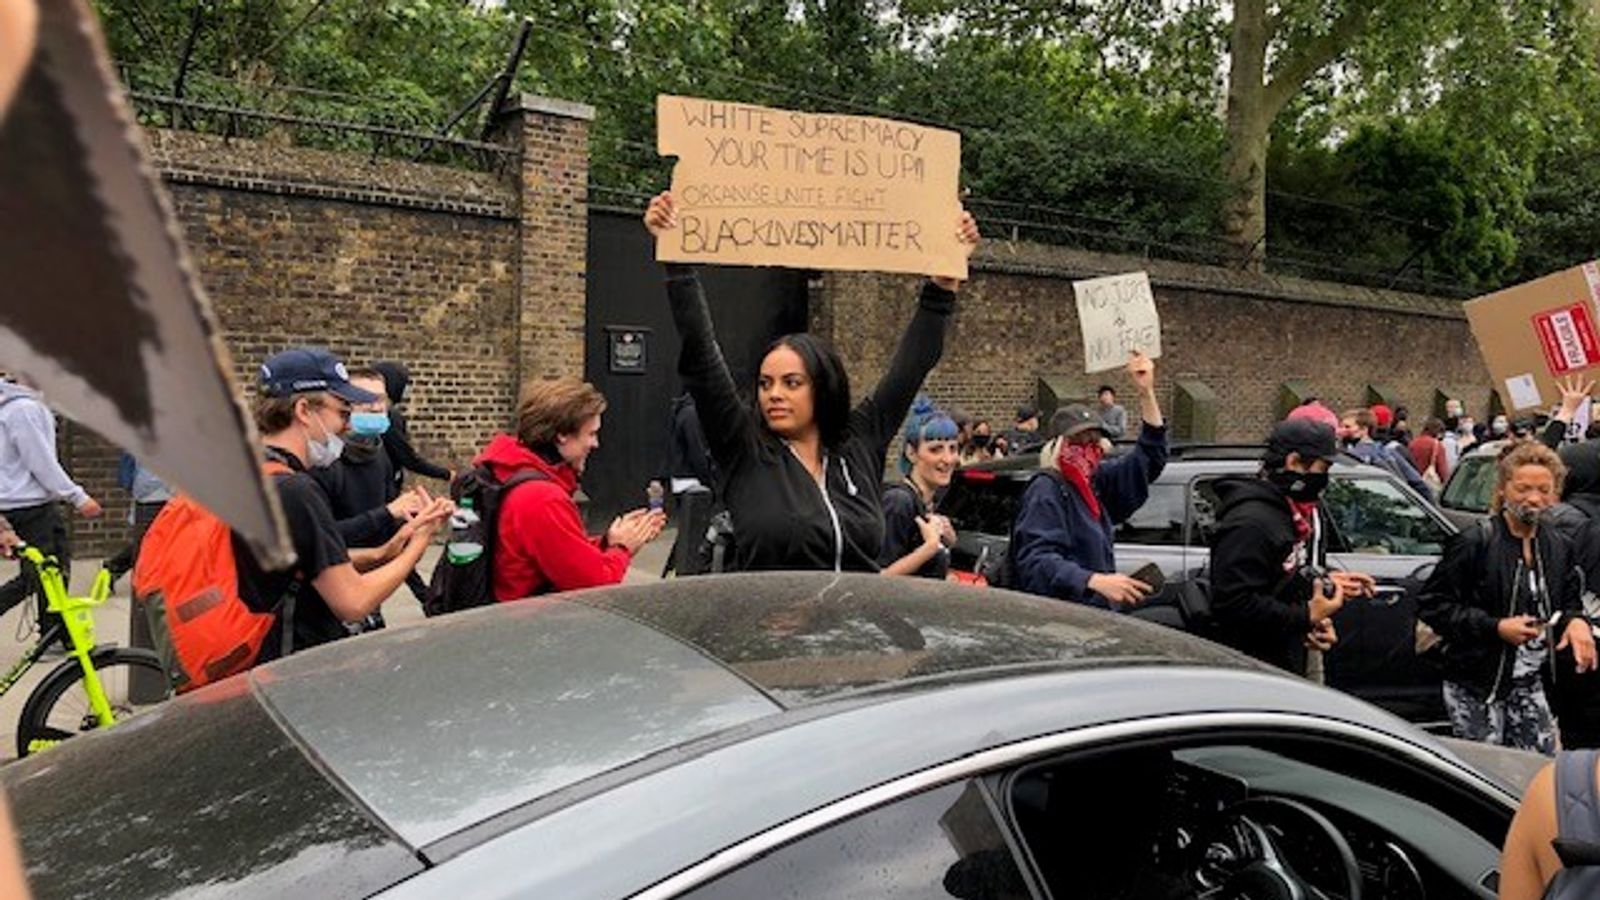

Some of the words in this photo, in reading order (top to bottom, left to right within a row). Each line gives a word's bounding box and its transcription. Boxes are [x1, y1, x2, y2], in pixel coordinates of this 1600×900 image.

[680, 103, 776, 135] WHITE
[788, 113, 926, 151] SUPREMACY
[705, 137, 769, 171] YOUR
[775, 142, 834, 175] TIME
[845, 149, 868, 176] IS
[775, 186, 824, 206] UNITE
[834, 186, 887, 207] FIGHT
